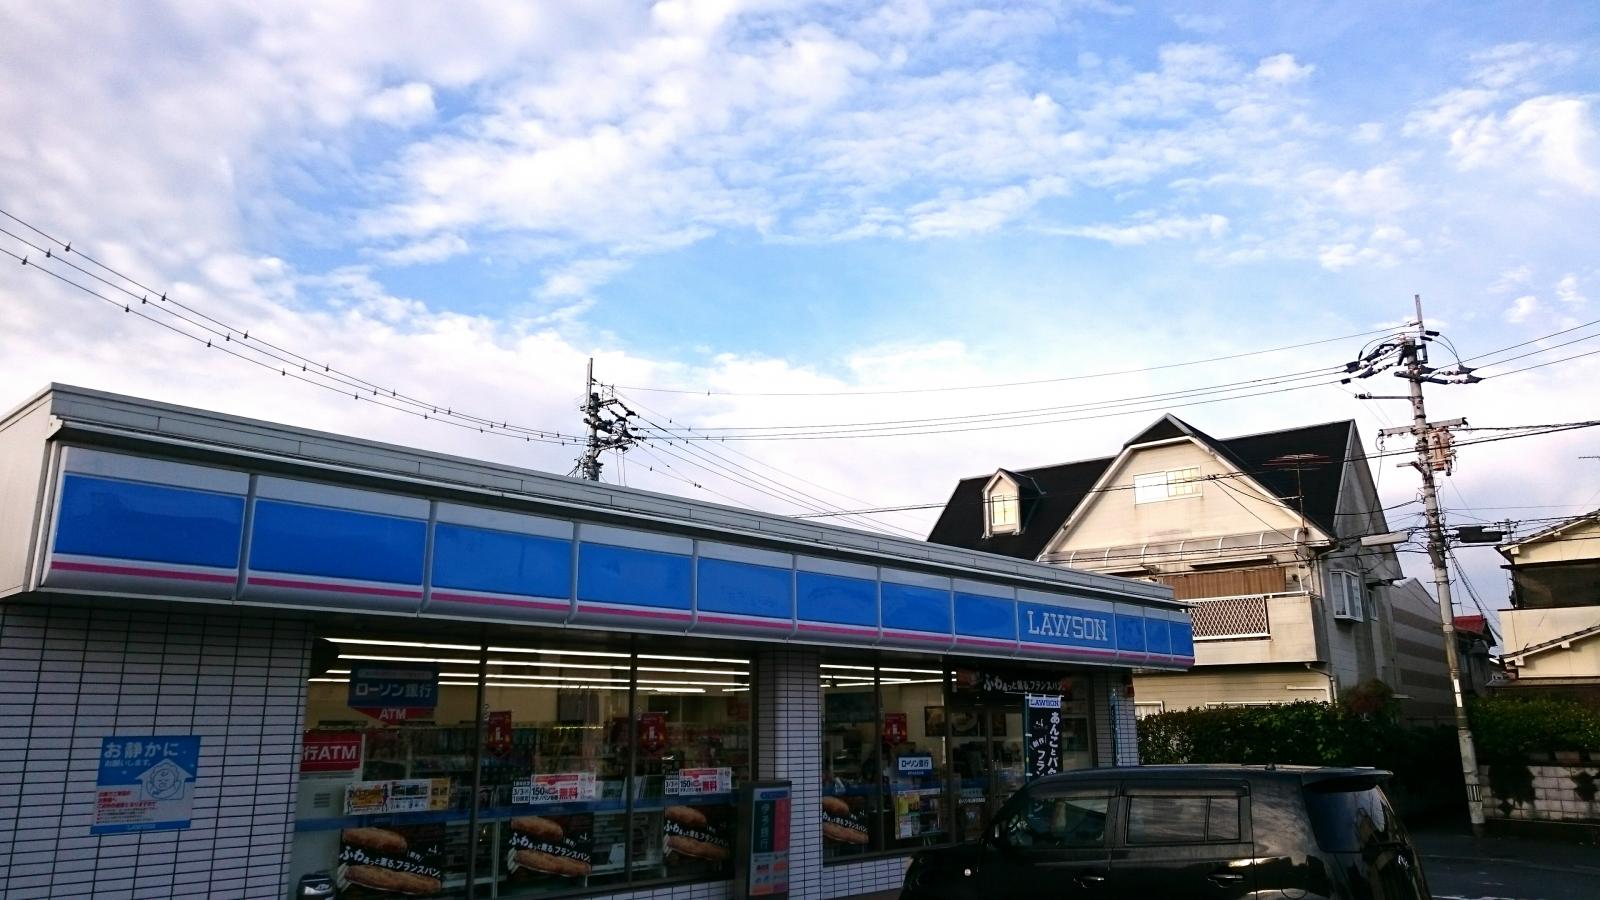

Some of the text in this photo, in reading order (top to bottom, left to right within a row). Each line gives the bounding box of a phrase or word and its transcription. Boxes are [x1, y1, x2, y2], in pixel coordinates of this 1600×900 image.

[1027, 610, 1108, 641] LAWSON
[355, 682, 432, 698] ローソン銀行
[1031, 699, 1060, 707] LAWSON
[378, 708, 407, 720] ATM
[103, 742, 178, 759] お静かに
[303, 745, 358, 761] 行ATM
[901, 760, 929, 768] ローソン銀行
[532, 787, 544, 795] 150
